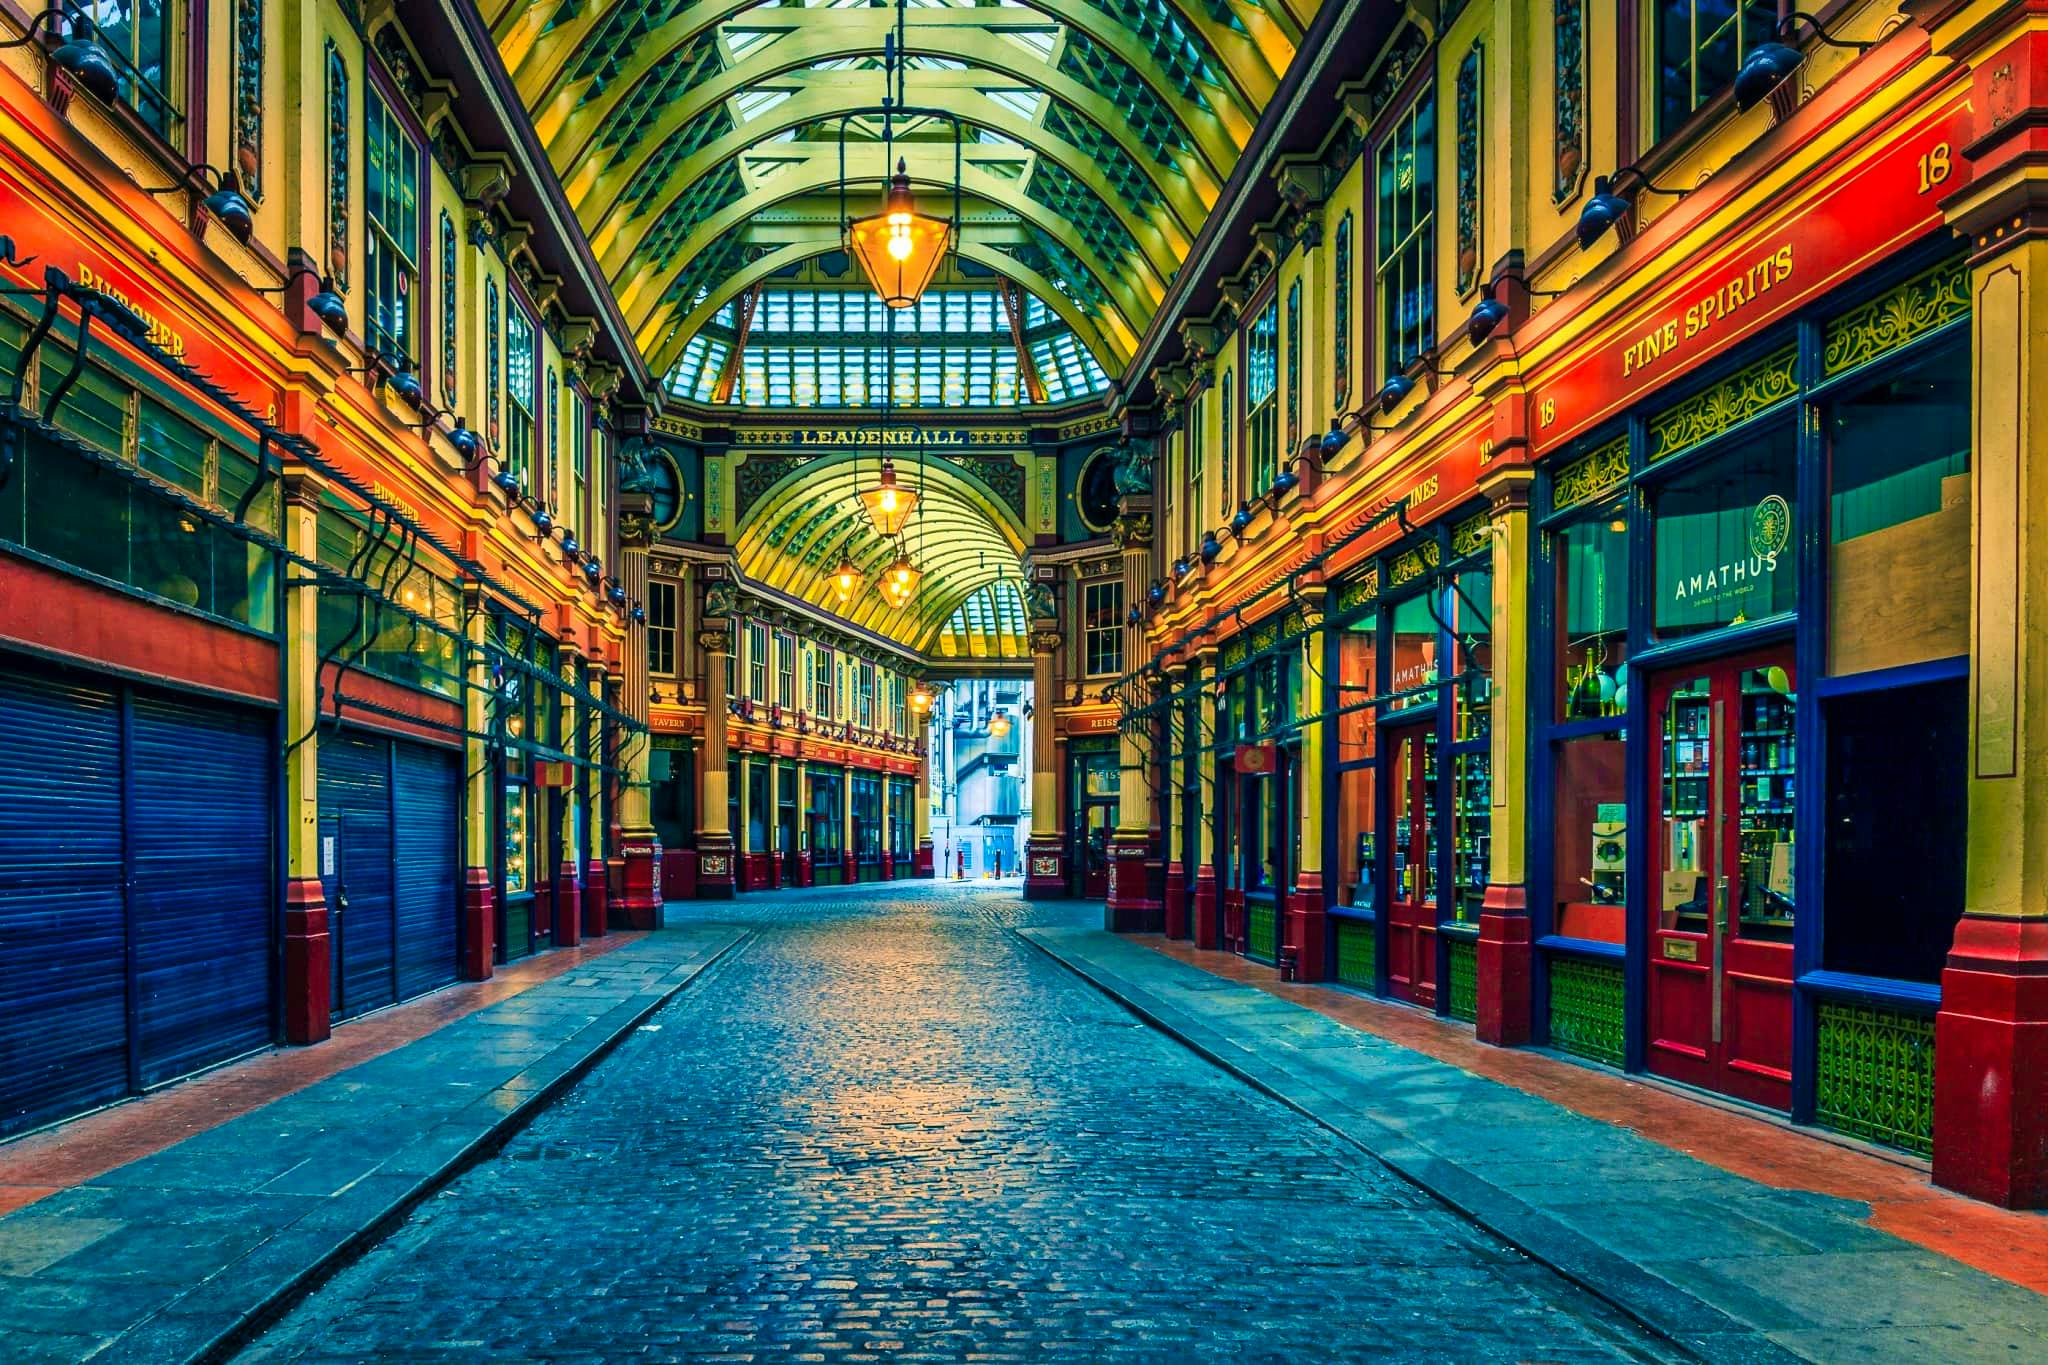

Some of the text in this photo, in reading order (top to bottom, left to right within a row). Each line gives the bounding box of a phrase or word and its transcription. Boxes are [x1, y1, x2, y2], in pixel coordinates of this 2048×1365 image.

[1918, 142, 1950, 194] 18
[1623, 244, 1793, 378] FINE SPIRITS
[1540, 398, 1555, 428] 18
[801, 431, 963, 445] LEADENHALL
[1405, 474, 1438, 511] INES
[1676, 550, 1777, 600] AMATHUS
[653, 718, 685, 728] TAVERN
[1091, 719, 1118, 729] REISS
